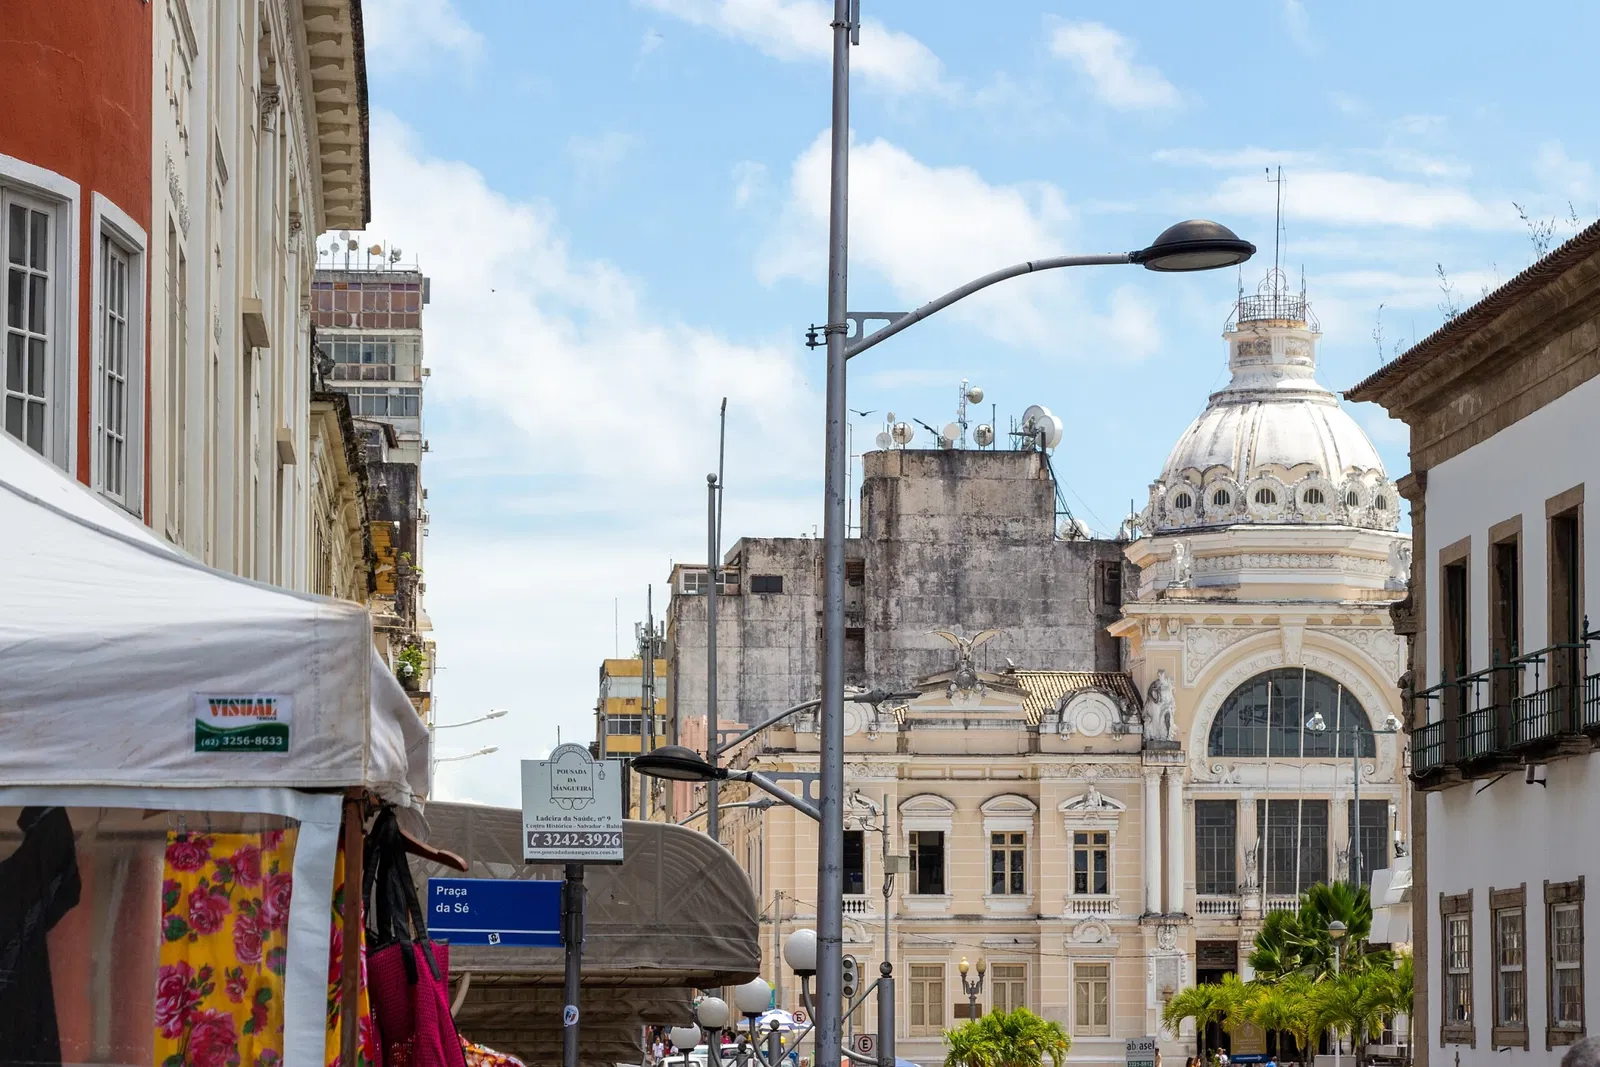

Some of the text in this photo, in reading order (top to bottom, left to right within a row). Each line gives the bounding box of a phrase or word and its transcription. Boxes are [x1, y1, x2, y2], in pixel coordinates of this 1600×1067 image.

[208, 698, 277, 717] VISUAL
[201, 736, 282, 747] (62) 3256-8633
[543, 833, 620, 846] 3242-3926
[436, 886, 467, 898] Praça
[436, 903, 469, 913] da Sé
[862, 1039, 868, 1049] E
